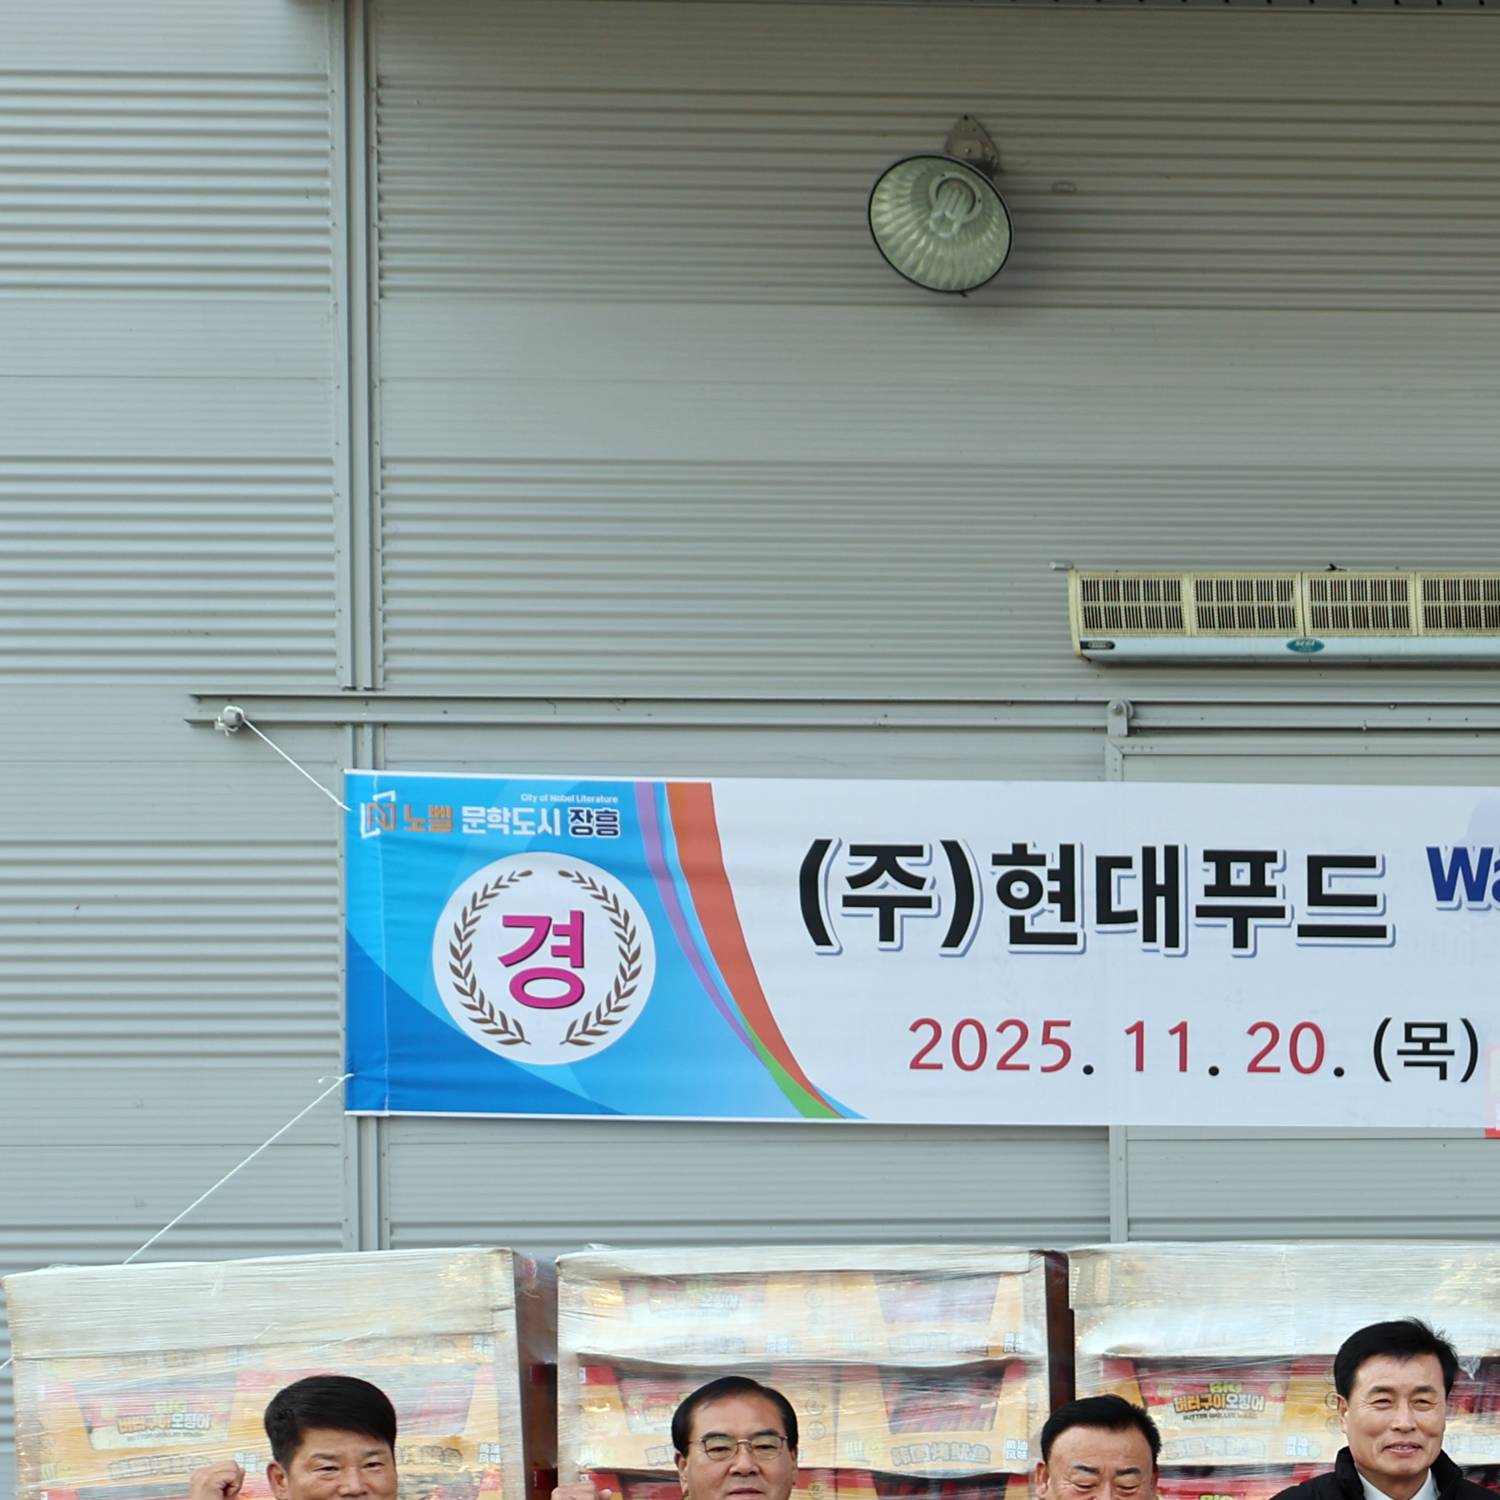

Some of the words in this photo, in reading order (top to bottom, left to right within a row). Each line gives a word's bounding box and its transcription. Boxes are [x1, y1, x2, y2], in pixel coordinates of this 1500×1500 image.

[403, 804, 453, 832] 노벨
[461, 805, 561, 836] 문학도시
[567, 807, 621, 838] 장흥
[799, 838, 1391, 951] (주)현대푸드
[497, 909, 588, 1010] 경
[908, 1017, 1095, 1076] 2025.
[1124, 1020, 1220, 1077] 11.
[1246, 1021, 1345, 1078] 20.
[1373, 1017, 1479, 1083] (목)
[1173, 1392, 1266, 1413] 버터구이오징어
